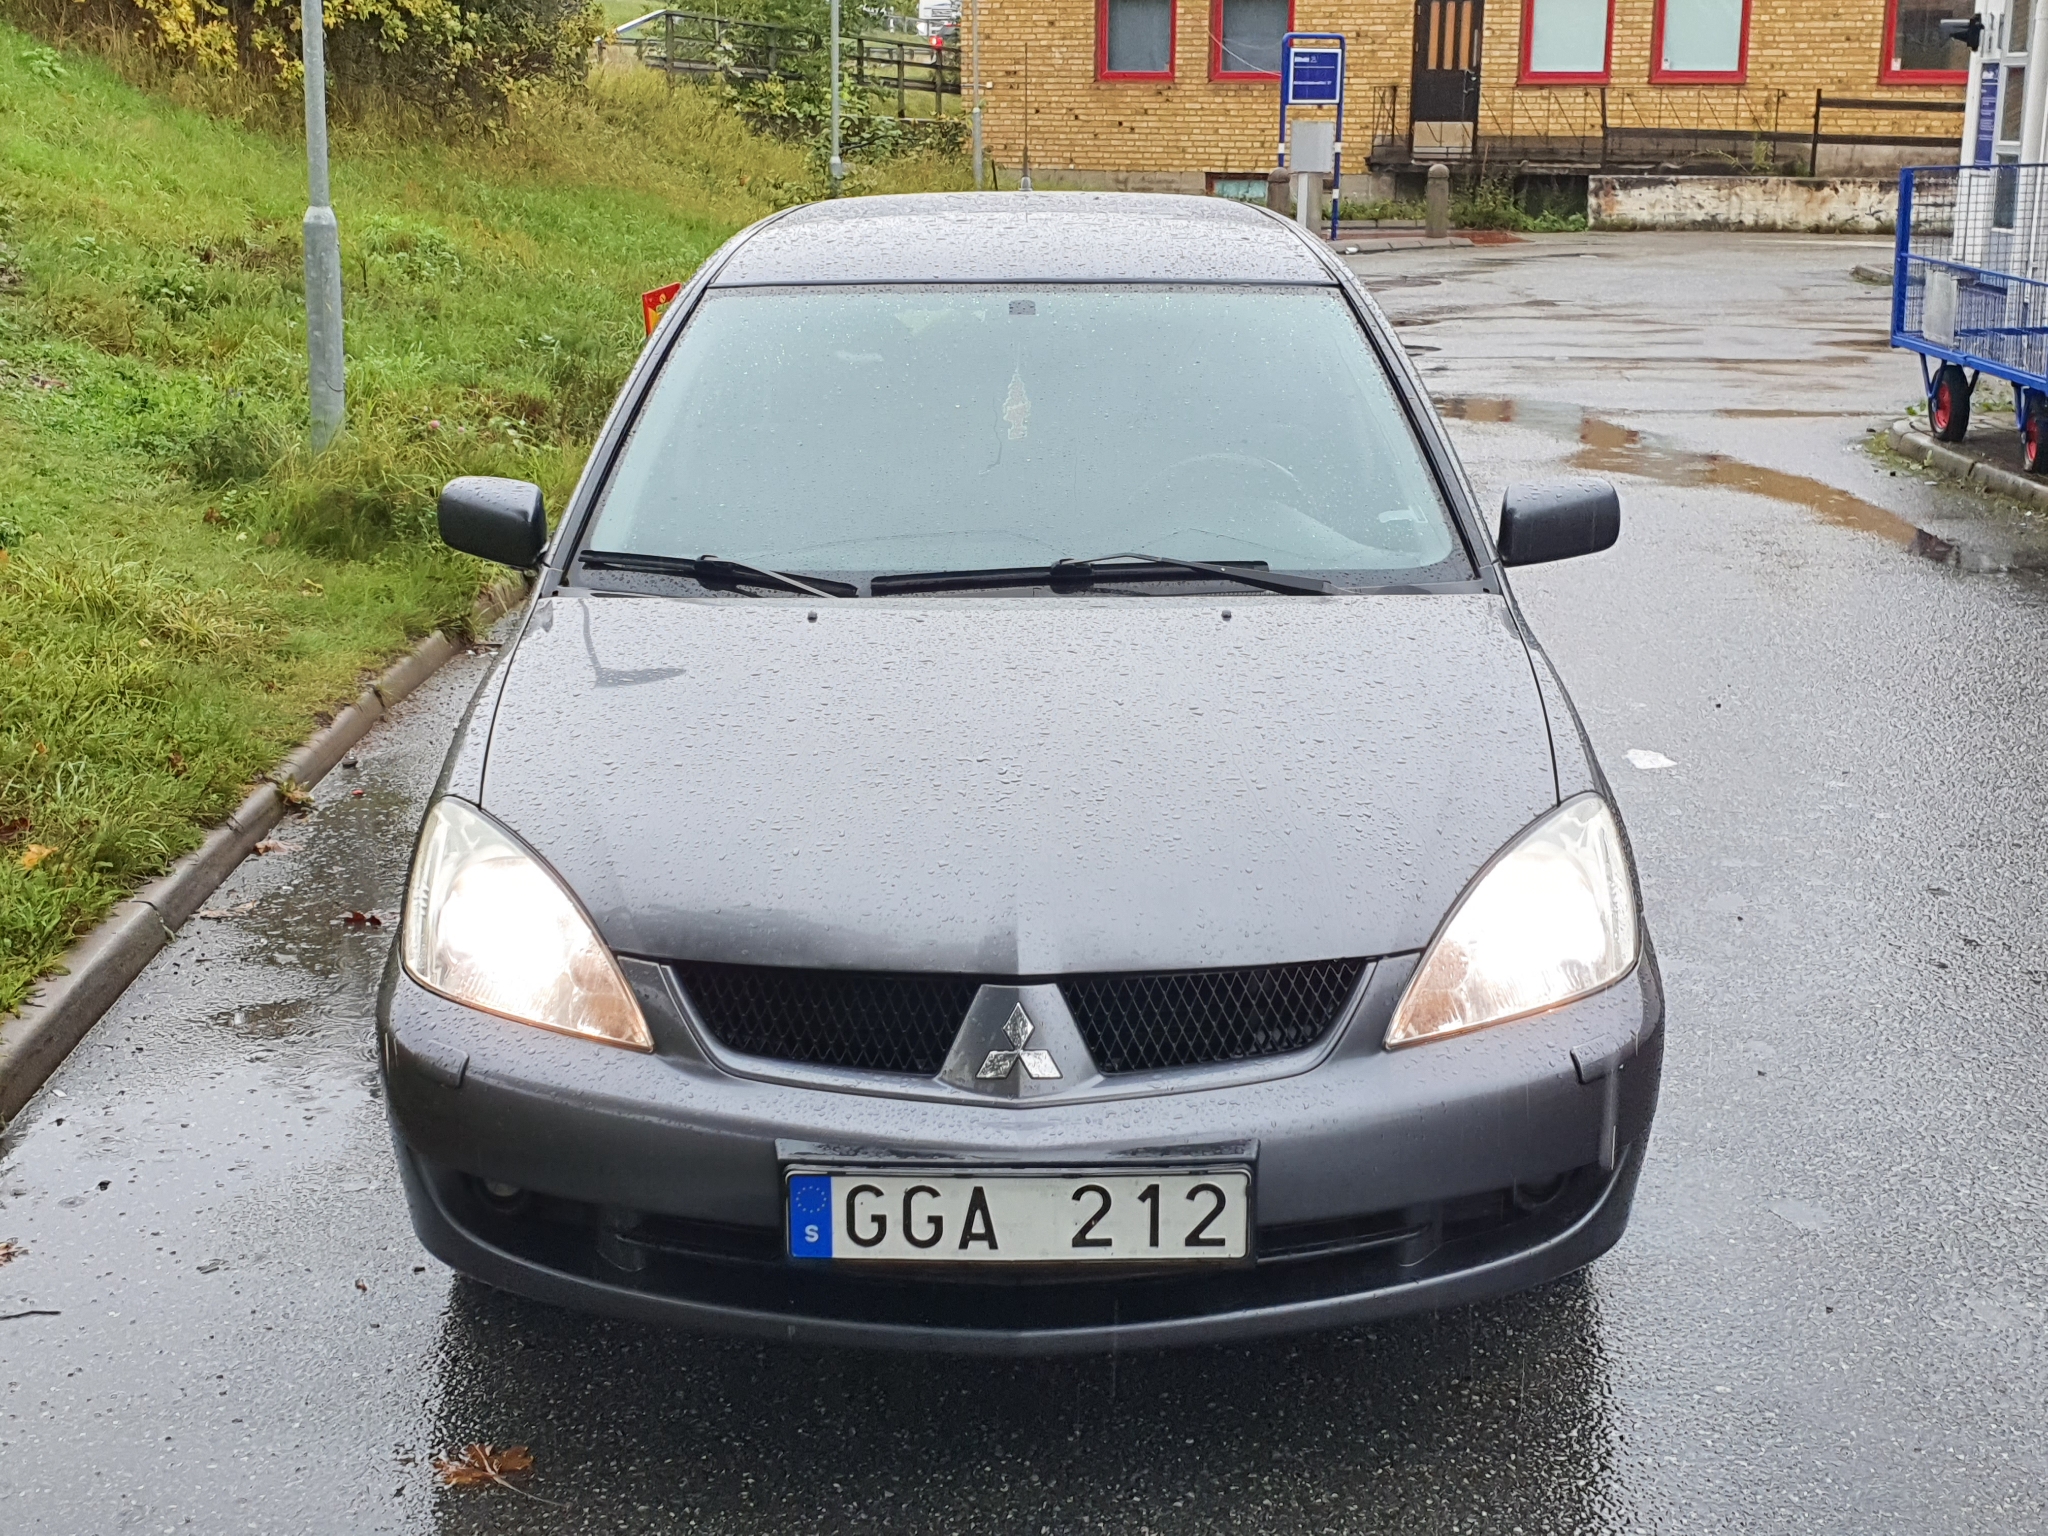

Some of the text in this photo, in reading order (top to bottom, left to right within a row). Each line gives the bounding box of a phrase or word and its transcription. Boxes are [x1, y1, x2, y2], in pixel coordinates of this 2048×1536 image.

[804, 1224, 820, 1243] S
[845, 1183, 1227, 1250] GGA 212
